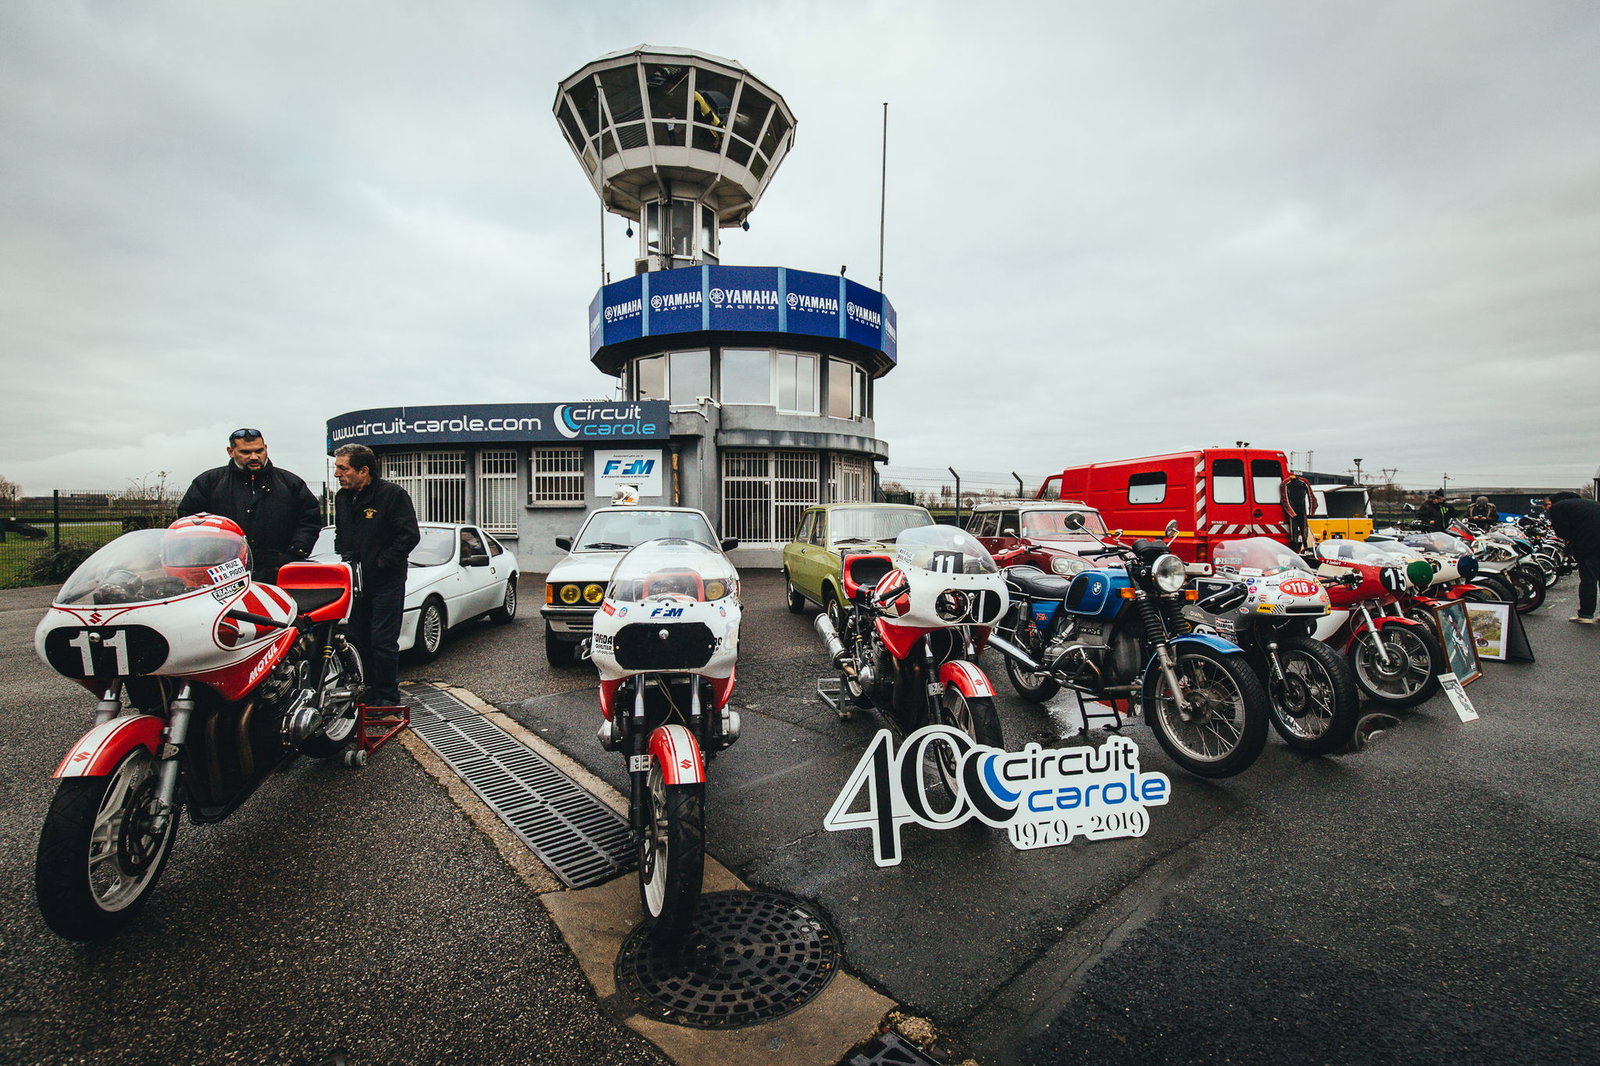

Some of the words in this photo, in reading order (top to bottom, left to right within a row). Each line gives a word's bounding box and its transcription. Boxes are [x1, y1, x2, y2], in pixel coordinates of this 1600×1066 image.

[662, 291, 703, 307] YAMAHA
[724, 289, 779, 305] YAMAHA
[798, 294, 839, 311] YAMAHA
[612, 298, 642, 318] YAMAHA
[655, 303, 700, 312] RACING
[790, 306, 836, 315] RACING
[855, 304, 881, 326] YAMAHA
[607, 312, 641, 323] RACING
[849, 316, 880, 329] RACING
[573, 404, 642, 421] circuit
[333, 415, 541, 442] www.circuit-carole.com
[583, 420, 656, 436] carole
[934, 554, 955, 574] 11
[1289, 581, 1309, 594] 116
[1383, 567, 1407, 592] 15
[214, 582, 240, 598] FRANCE
[69, 630, 130, 677] 11
[248, 642, 279, 685] MOTUL
[830, 730, 971, 860] 40
[1002, 741, 1136, 782] circuit
[1027, 772, 1166, 814] carole
[1013, 818, 1069, 847] 1979
[1091, 810, 1145, 834] 2019
